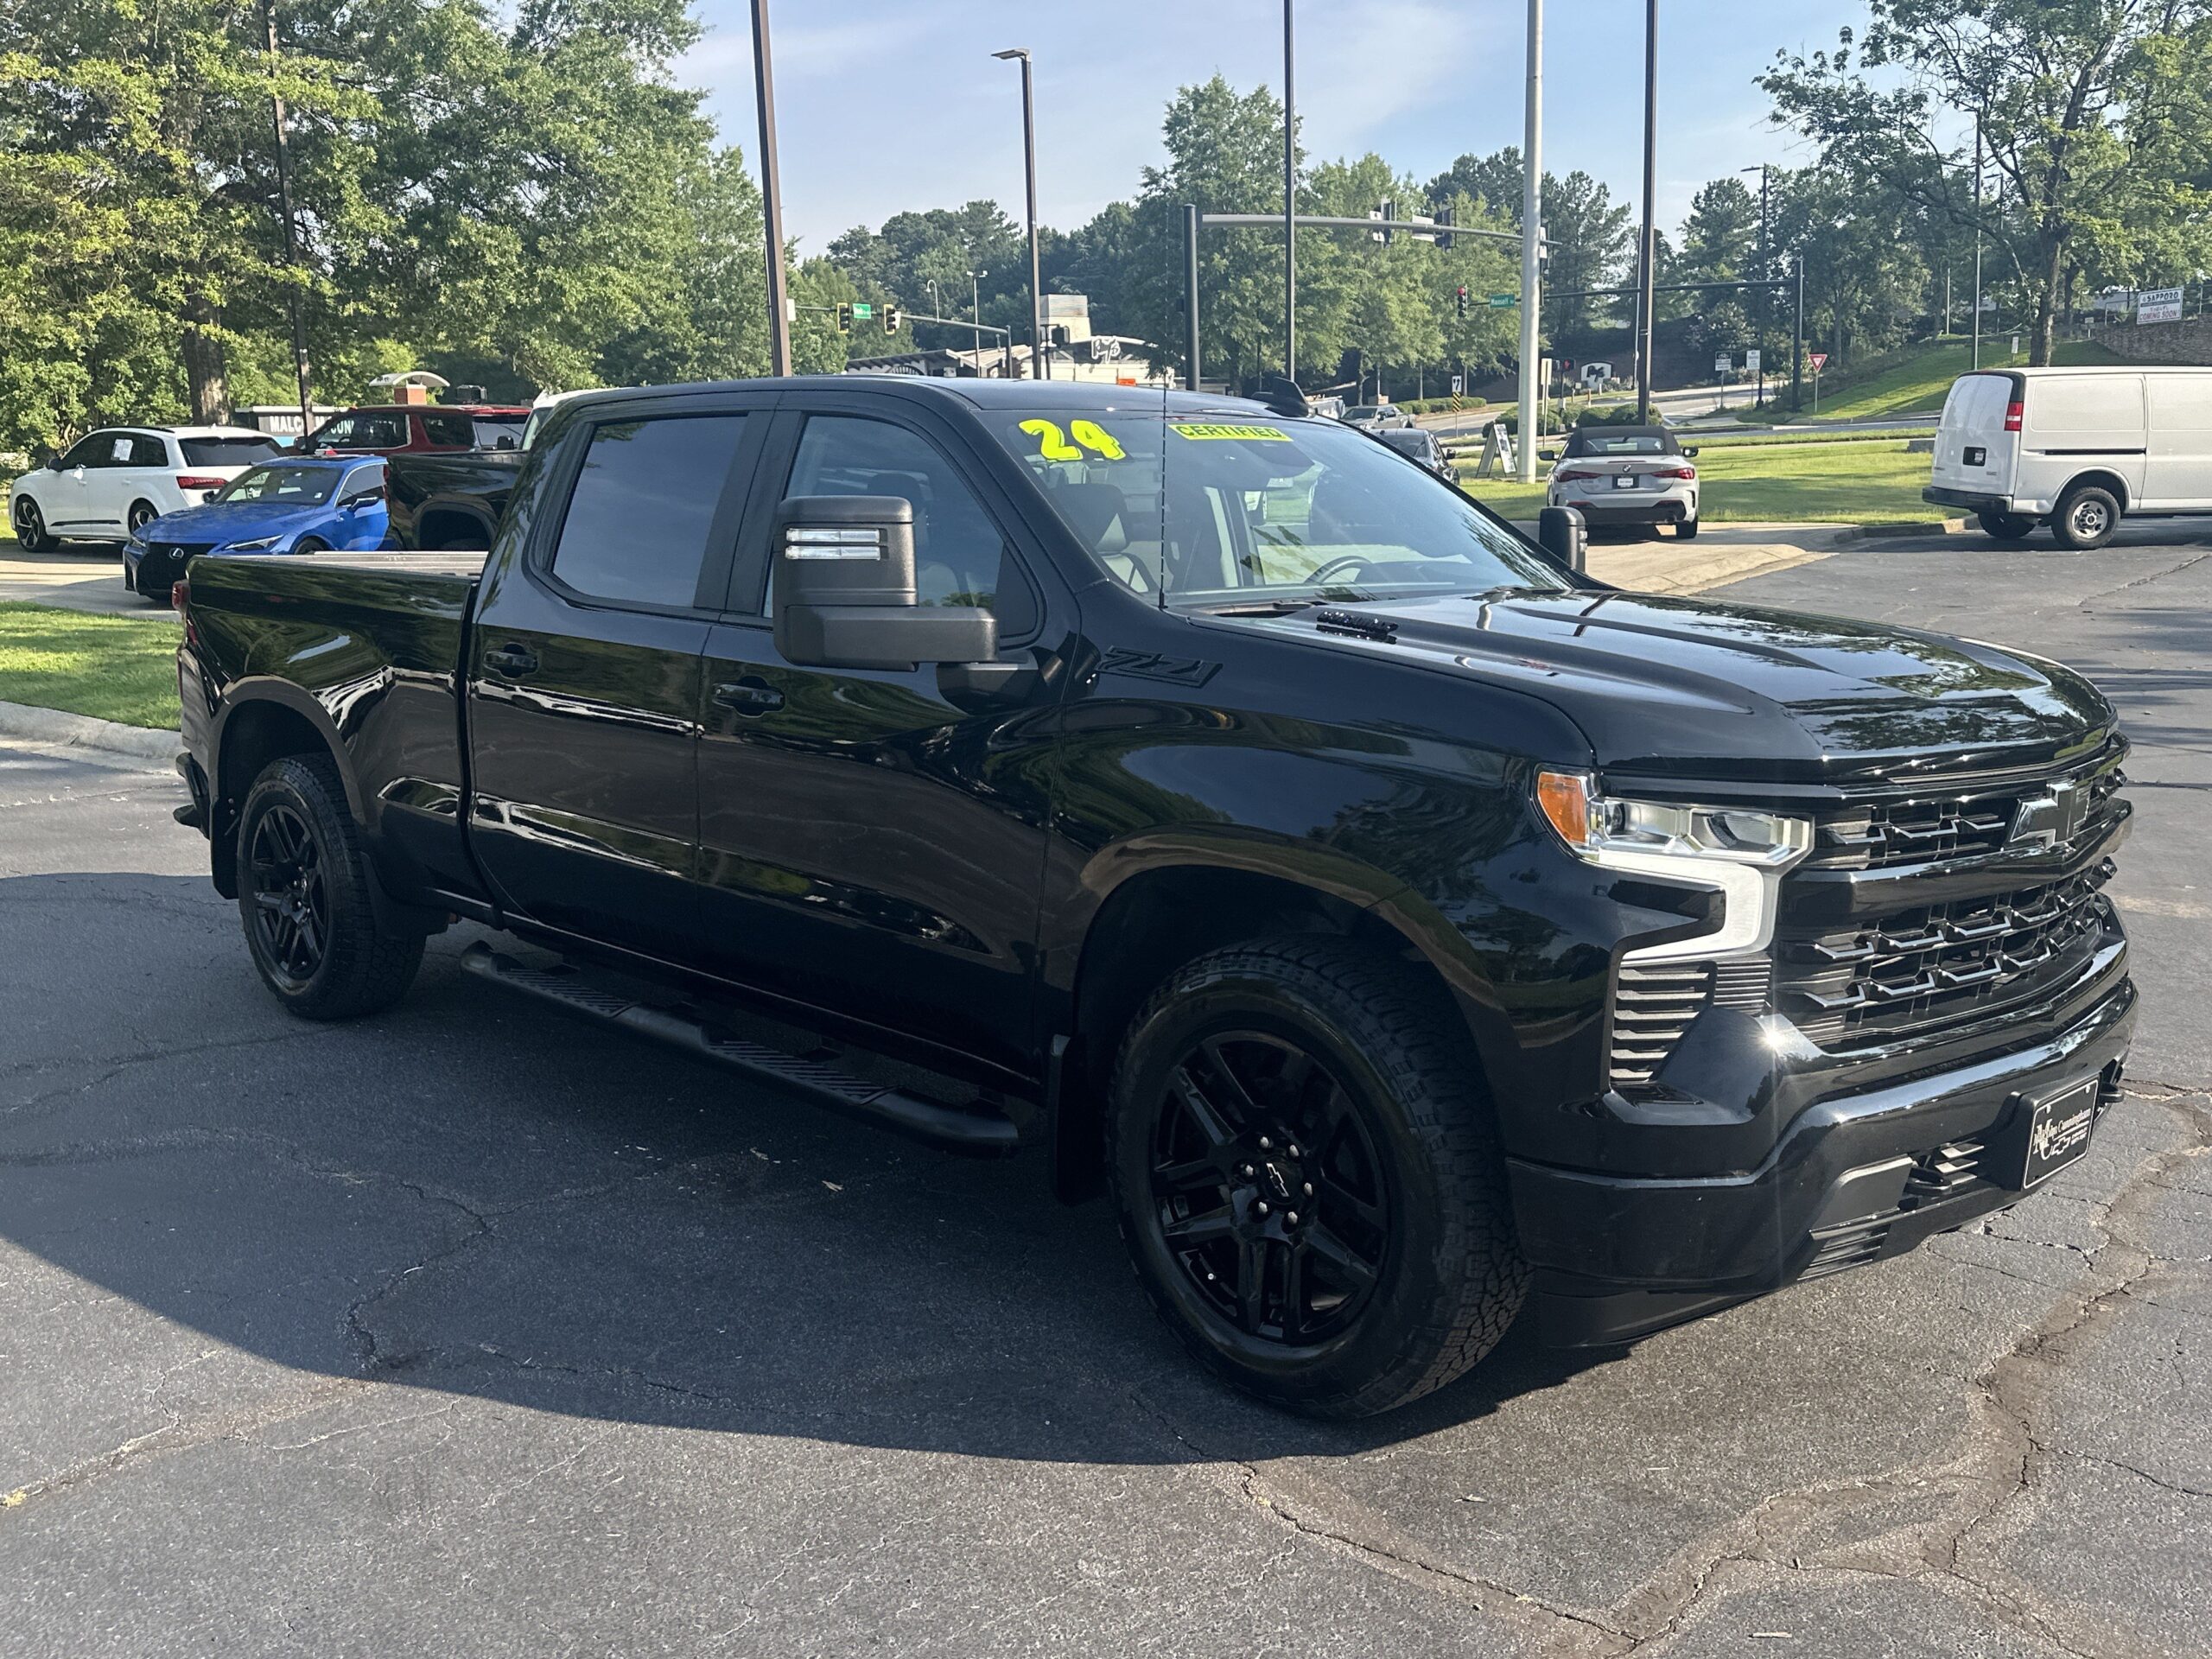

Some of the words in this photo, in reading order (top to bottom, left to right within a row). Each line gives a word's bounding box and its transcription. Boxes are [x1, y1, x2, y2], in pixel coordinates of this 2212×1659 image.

[2146, 291, 2179, 302] SAPPORO
[2139, 311, 2161, 321] COMING
[1176, 424, 1285, 439] CERTIFIED
[1018, 417, 1127, 462] 24
